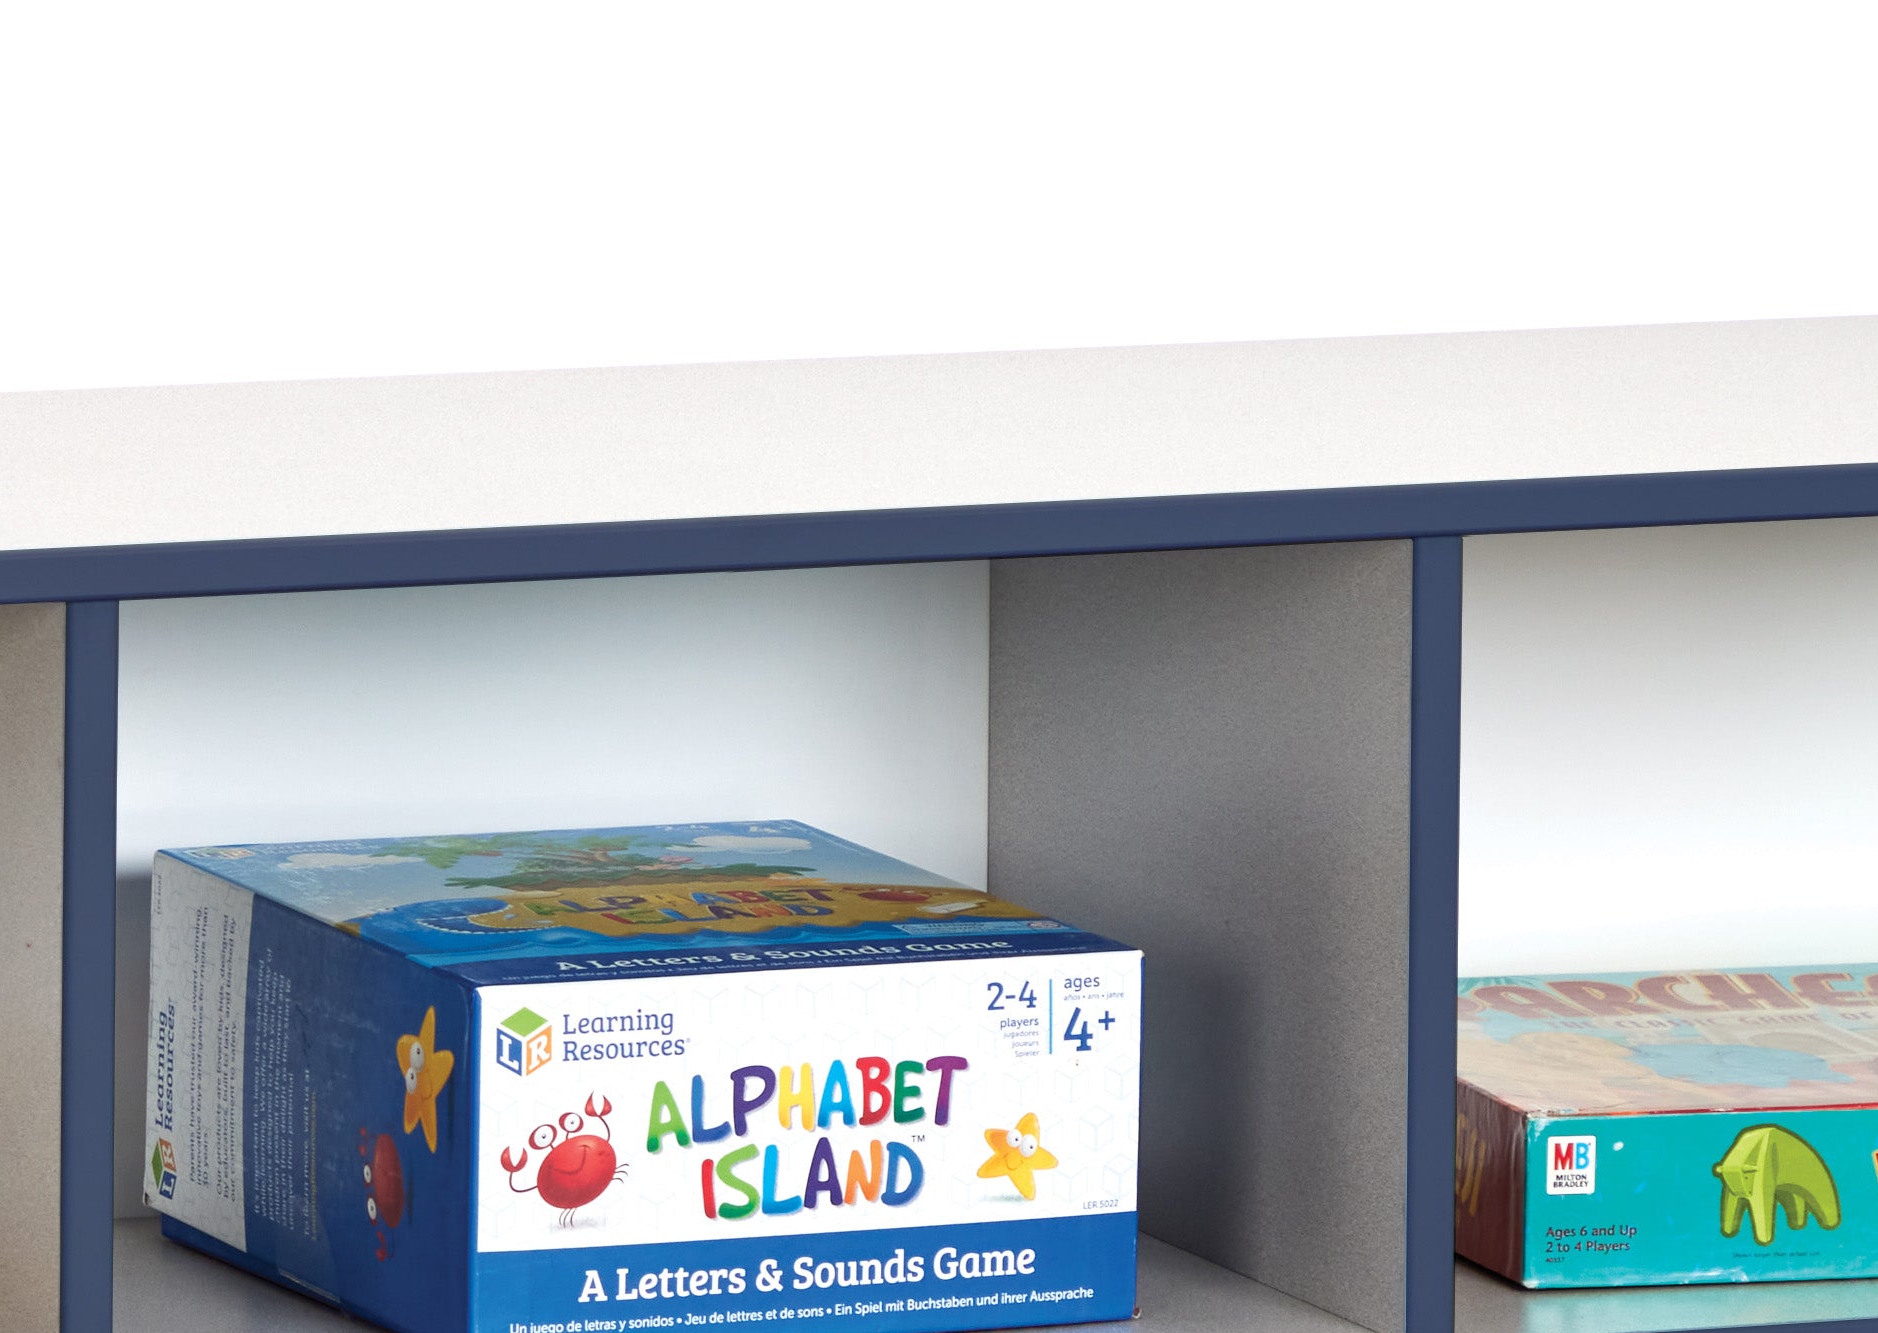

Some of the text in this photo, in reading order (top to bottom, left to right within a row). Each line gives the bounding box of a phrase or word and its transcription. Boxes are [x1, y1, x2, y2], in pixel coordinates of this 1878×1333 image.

[556, 939, 1013, 971] A Letters & Sounds Game
[987, 980, 1037, 1011] 2-4
[1064, 976, 1100, 991] ages
[563, 1009, 673, 1035] Learning
[1000, 1016, 1039, 1031] players
[1064, 1006, 1116, 1052] 4+
[562, 1038, 685, 1061] Resources
[155, 1011, 168, 1127] Learning
[164, 1004, 175, 1131] Resources
[646, 1055, 969, 1153] ALPHABET
[1553, 1141, 1590, 1172] MB
[701, 1136, 925, 1221] ISLAND
[1553, 1179, 1589, 1189] BRADLEY
[1555, 1173, 1588, 1182] MILTON
[1083, 1199, 1120, 1211] LER 5022
[1546, 1224, 1638, 1240] Ages 6 and Up
[1546, 1240, 1631, 1255] 2 to 4 Players
[577, 1246, 1036, 1303] A Letters & Sounds Game
[570, 1320, 583, 1333] de
[584, 1318, 617, 1332] letras
[618, 1320, 627, 1333] y
[628, 1314, 674, 1329] sonidos
[684, 1313, 707, 1327] Jeu
[708, 1311, 725, 1325] de
[726, 1308, 764, 1323] lettres
[765, 1309, 778, 1320] et
[779, 1306, 795, 1320] de
[797, 1305, 824, 1319] sons
[834, 1303, 853, 1316] Ein
[854, 1300, 883, 1317] Spiel
[885, 1299, 905, 1313] mit
[907, 1295, 974, 1311] Buchstaben
[976, 1293, 999, 1306] und
[1000, 1291, 1028, 1305] ihrer
[1029, 1286, 1094, 1304] Aussprache
